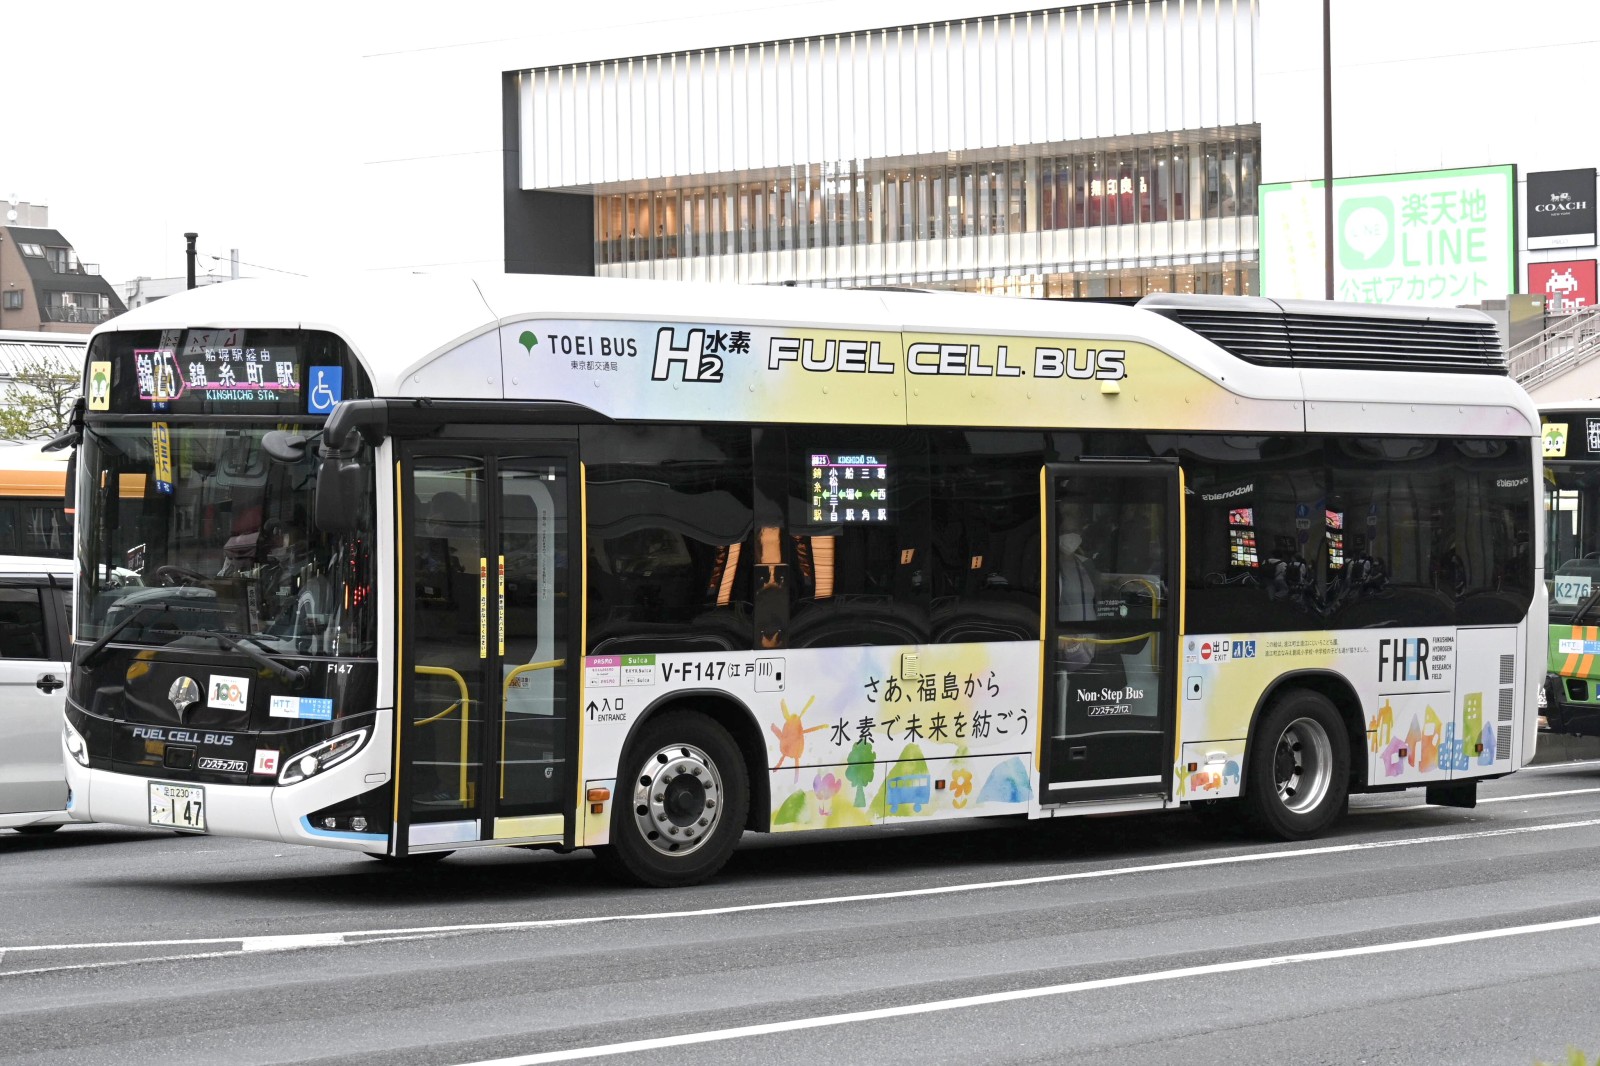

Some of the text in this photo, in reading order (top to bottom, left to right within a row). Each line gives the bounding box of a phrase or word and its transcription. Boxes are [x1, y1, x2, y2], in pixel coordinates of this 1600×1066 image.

[1402, 189, 1487, 227] 楽天地
[1535, 201, 1586, 213] COACH
[1402, 227, 1487, 267] LINE
[1340, 271, 1488, 304] 公式アカウント
[548, 334, 638, 358] TOEI BUS
[705, 330, 750, 355] 水素
[205, 349, 271, 362] 船堀駅経由
[768, 337, 895, 374] FUEL
[570, 360, 618, 372] 東京都交通局
[188, 361, 295, 388] 錦糸町駅
[258, 389, 280, 400] STA.
[1556, 582, 1590, 599] K276
[1212, 640, 1230, 653] 出口
[1432, 645, 1453, 653] HYDROGEN
[1214, 653, 1227, 662] EXIT
[1378, 637, 1430, 683] FH2R
[1431, 654, 1447, 662] ENERGY
[327, 664, 353, 675] F147
[661, 662, 726, 682] V-F147
[1431, 663, 1452, 671] RESEARCH
[864, 671, 1000, 702] さあ、福島から
[1125, 686, 1144, 700] Bus
[601, 698, 624, 711] 入口
[1090, 705, 1130, 715] ノンステップバス
[598, 713, 626, 722] ENTRANCE
[830, 708, 1029, 746] 水素で未来を紡ごう
[132, 728, 234, 746] FUEL CELL BUS
[200, 759, 245, 772] ノンステップバス
